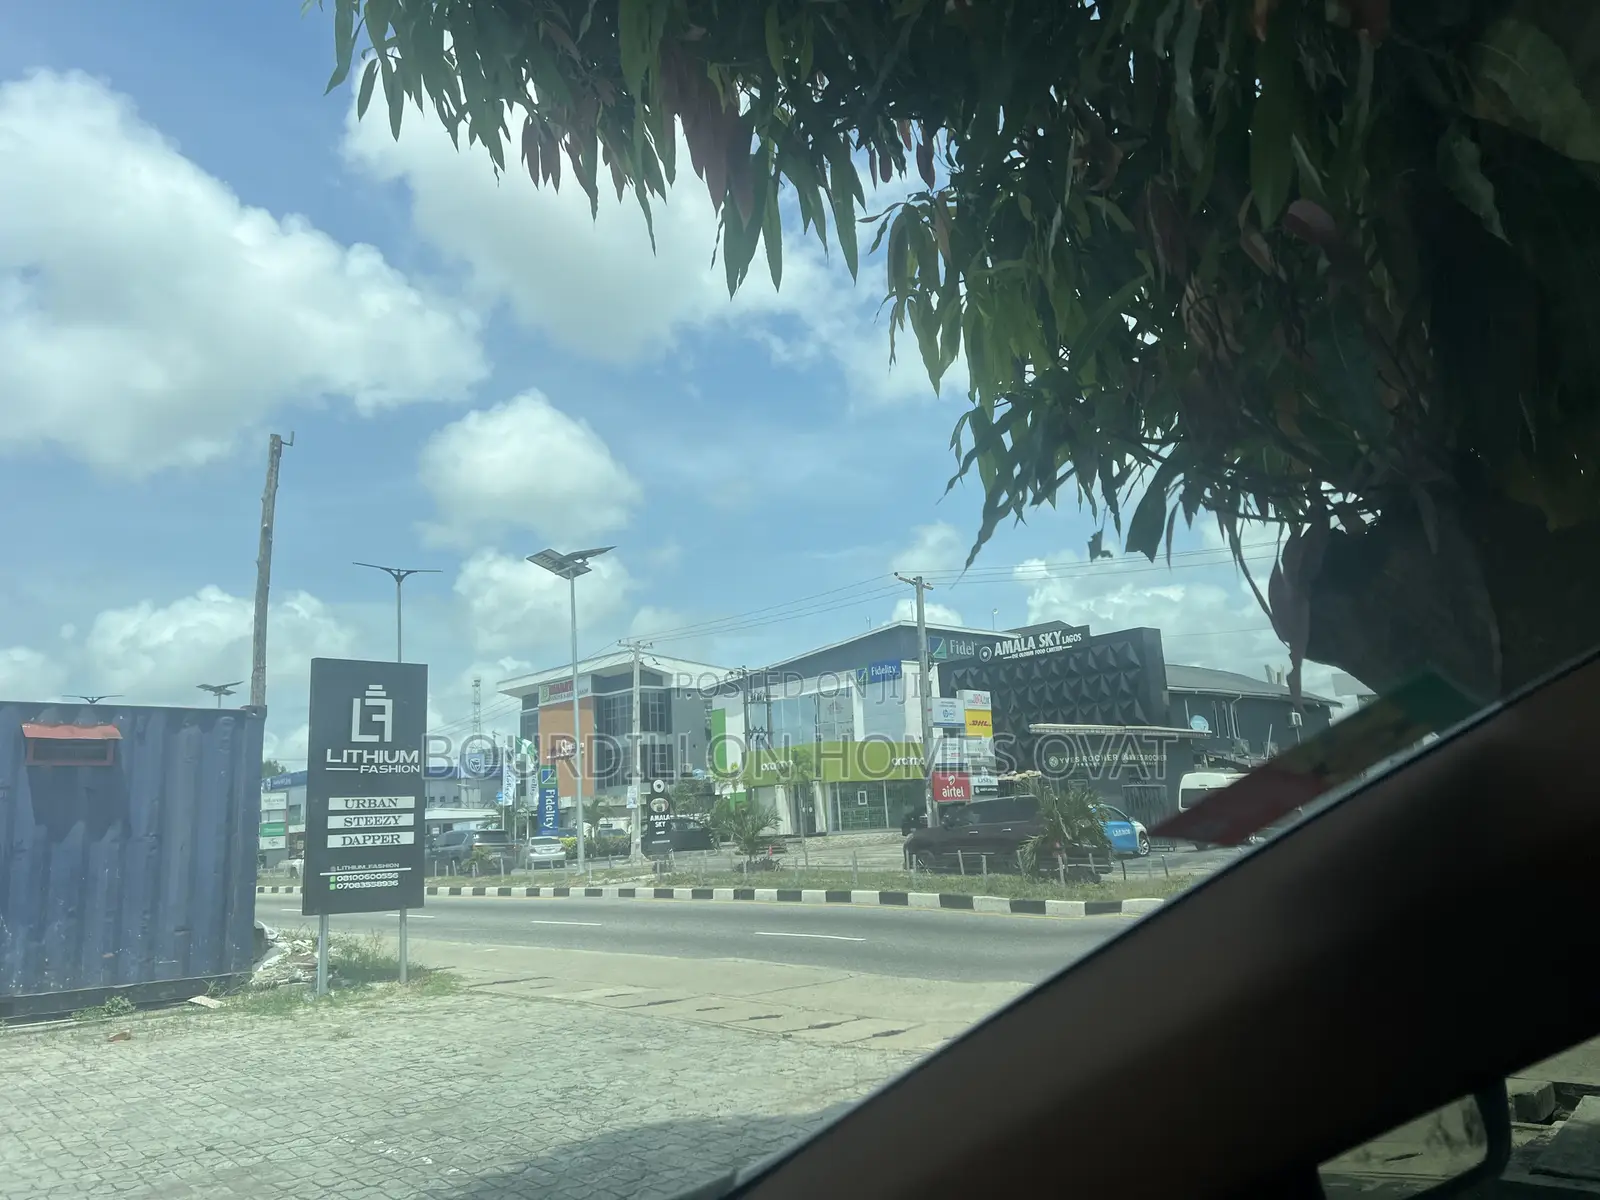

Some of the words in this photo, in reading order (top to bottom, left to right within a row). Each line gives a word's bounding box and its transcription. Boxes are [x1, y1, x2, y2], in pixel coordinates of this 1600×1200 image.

[950, 639, 978, 656] Fidel
[994, 635, 1036, 657] AMALA
[1038, 630, 1062, 648] SKY
[1061, 633, 1082, 645] LAGOS
[871, 664, 897, 676] Fidelity
[326, 748, 419, 764] LITHIUM
[1059, 756, 1080, 764] YVES
[1082, 754, 1118, 762] ROCHER
[360, 764, 420, 774] FASHION
[941, 785, 966, 798] airtel
[344, 797, 399, 809] URBAN
[543, 789, 556, 829] Fidelity
[343, 815, 402, 827] STEEZY
[650, 814, 670, 822] AMALA
[341, 834, 401, 846] DAPPER
